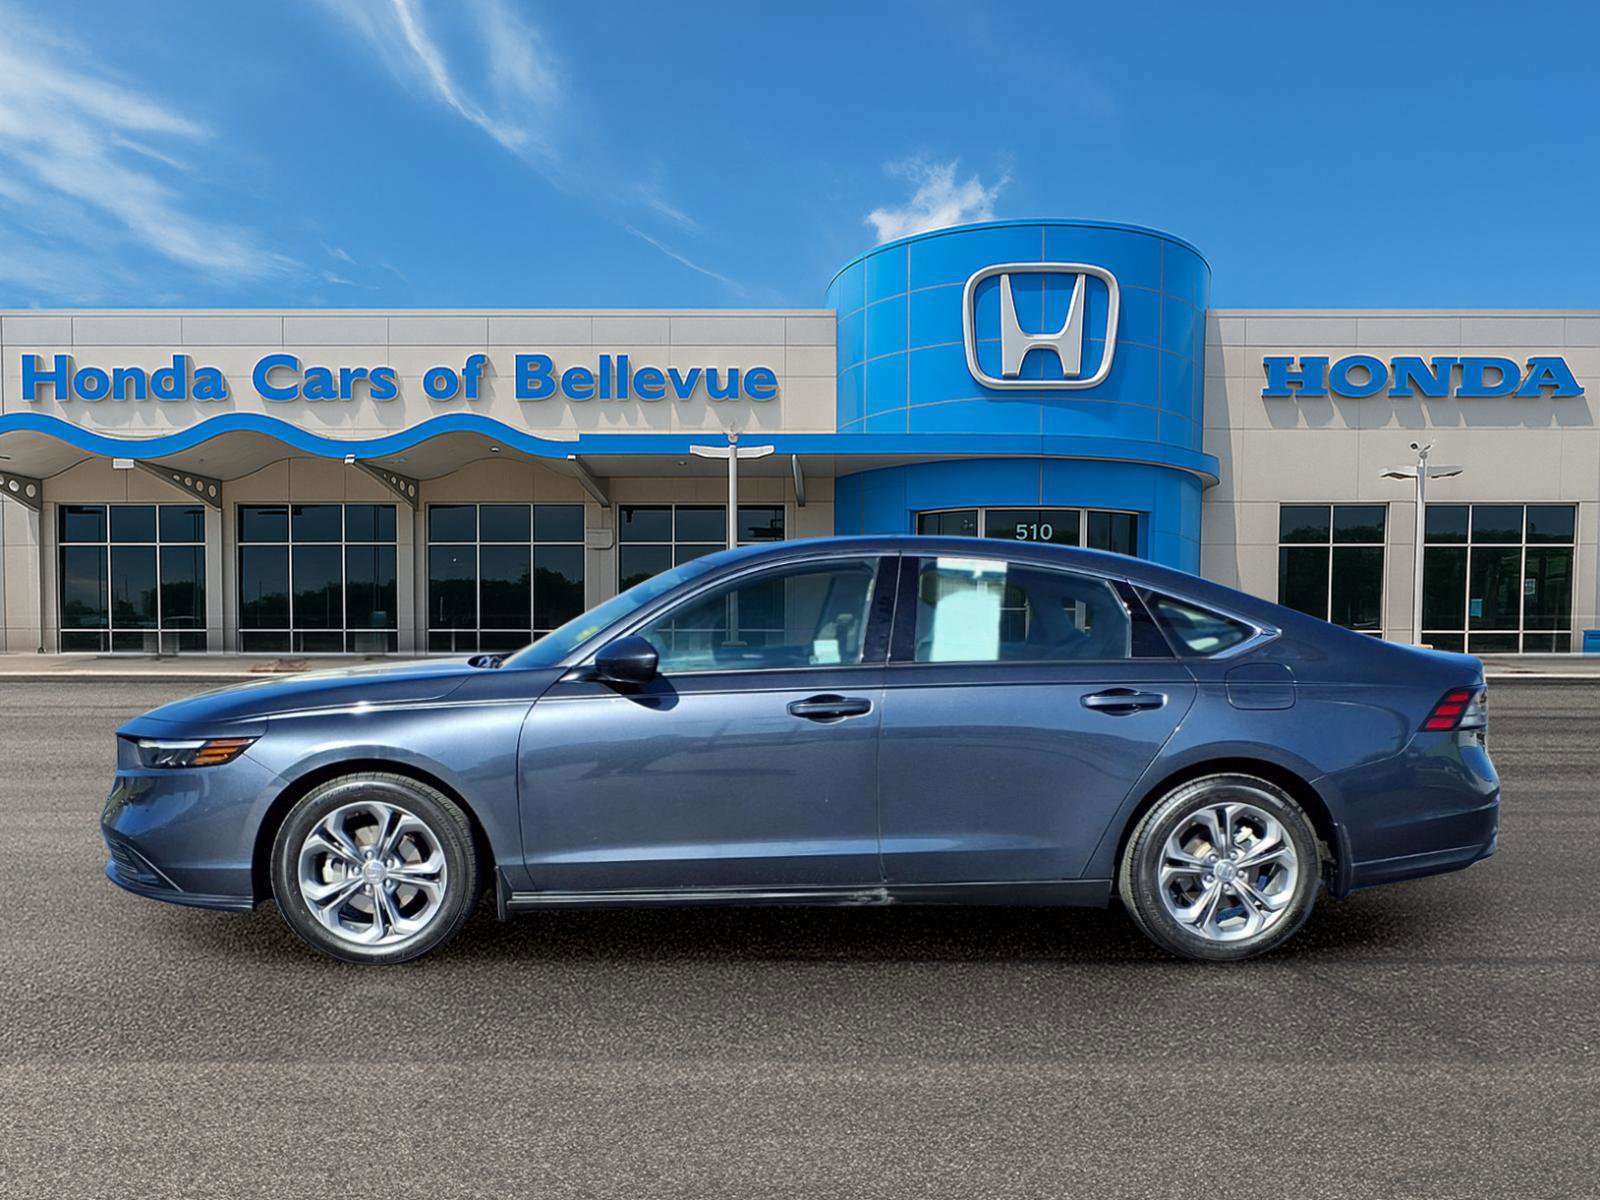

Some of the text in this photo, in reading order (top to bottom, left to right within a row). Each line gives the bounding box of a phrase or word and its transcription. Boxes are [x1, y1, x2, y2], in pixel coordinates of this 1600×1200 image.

[21, 353, 779, 401] Honda Cars of Bellevue
[1262, 355, 1585, 398] HONDA
[1015, 523, 1053, 540] 510
